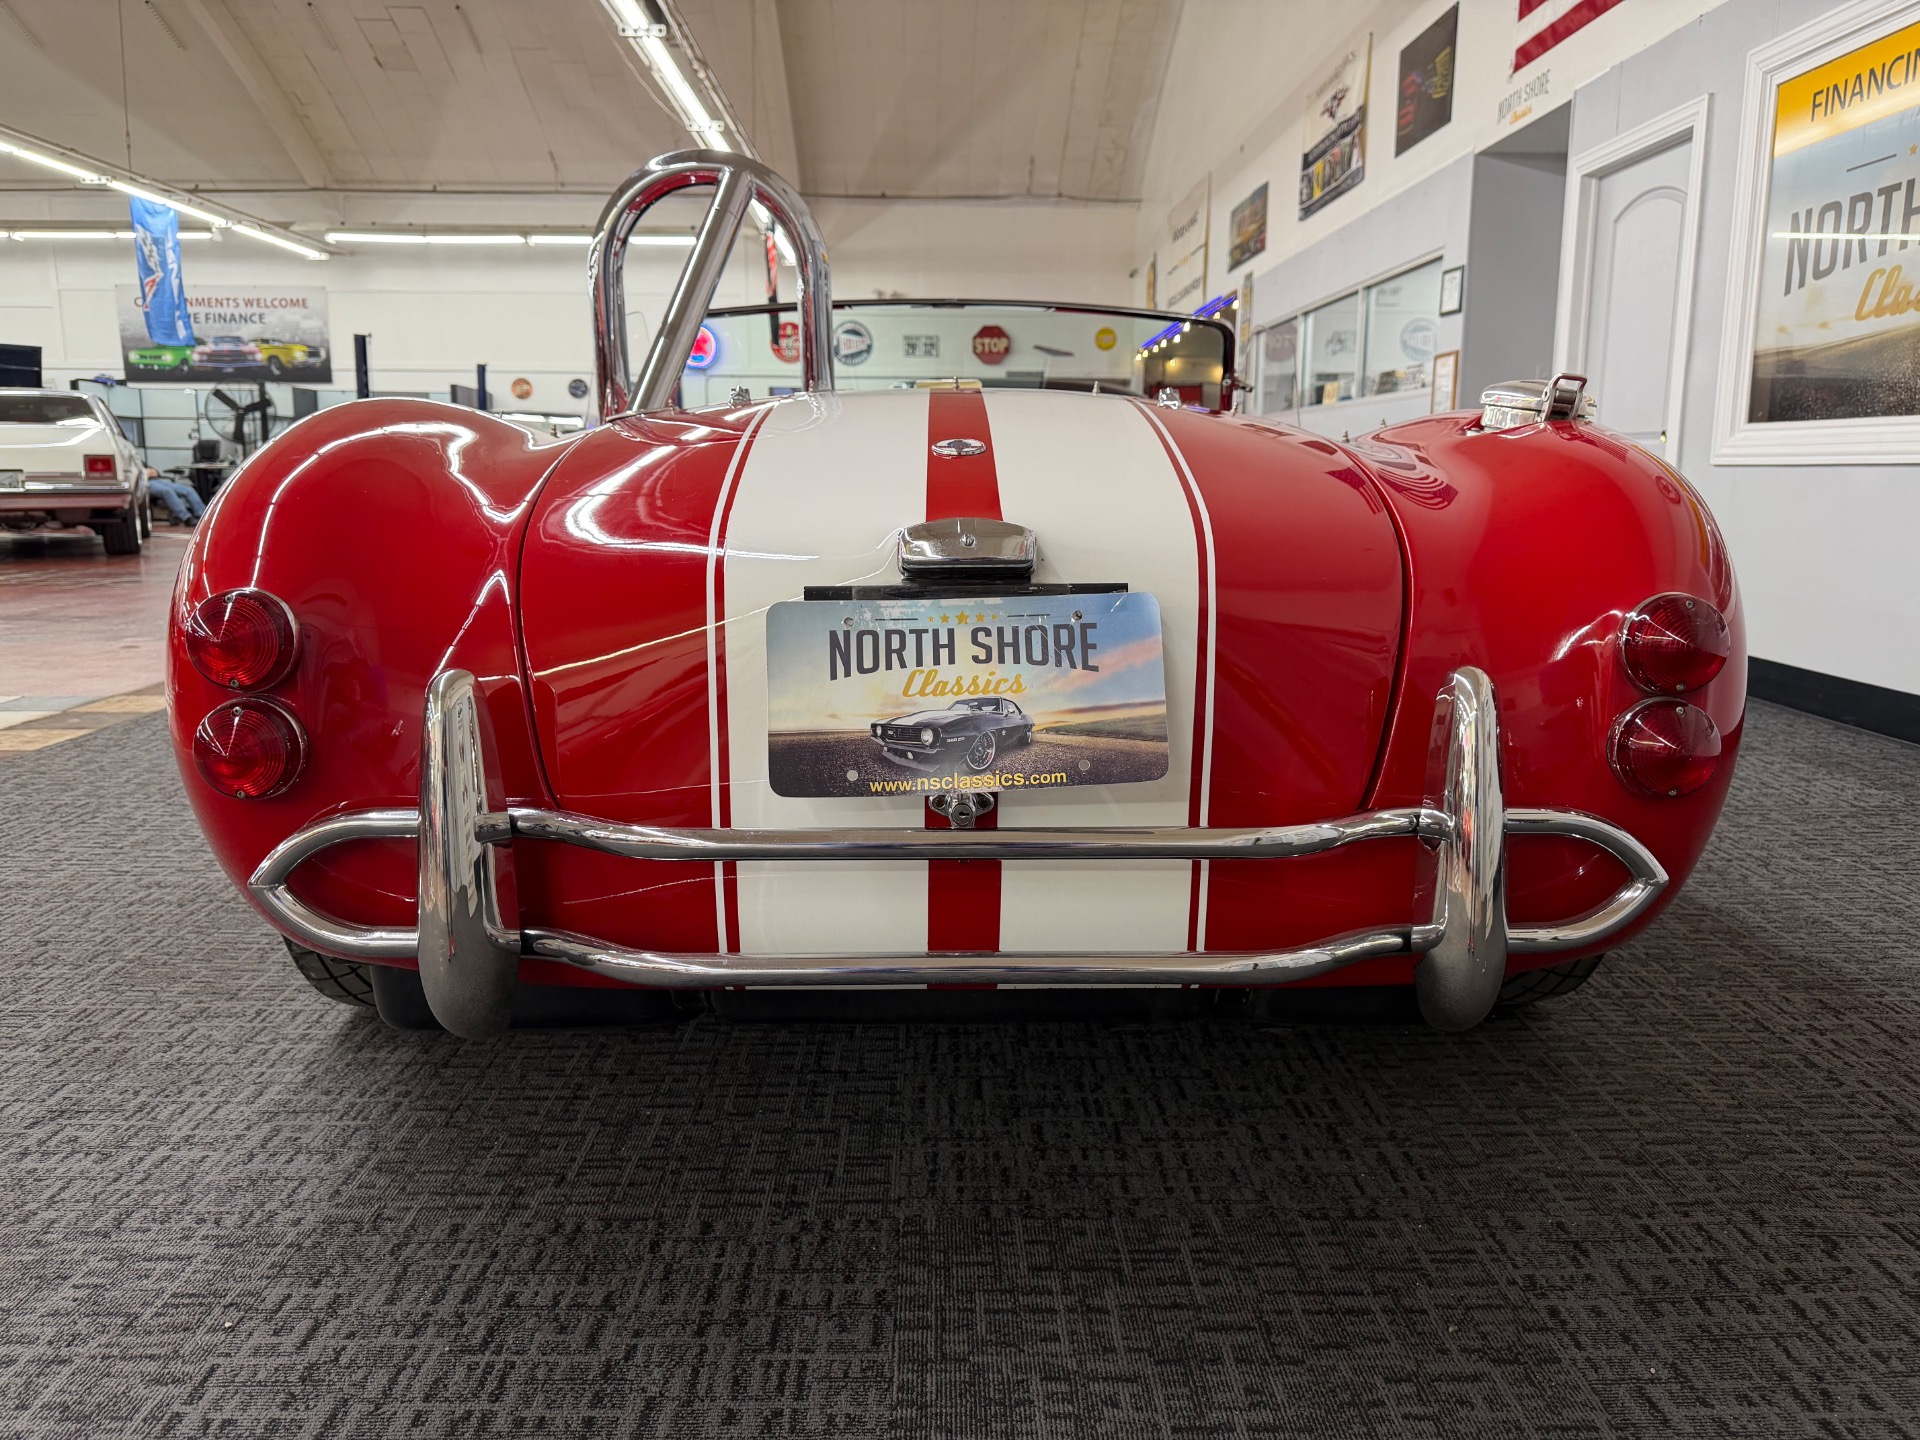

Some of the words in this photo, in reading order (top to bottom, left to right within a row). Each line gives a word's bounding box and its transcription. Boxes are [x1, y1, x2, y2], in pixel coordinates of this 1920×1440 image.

[1496, 87, 1522, 125] NORTH
[1523, 68, 1551, 102] SHORE
[243, 297, 309, 309] WELCOME
[204, 312, 267, 325] FINANCE
[974, 337, 1009, 354] STOP
[829, 627, 956, 681] NORTH
[970, 622, 1100, 673] SHORE
[901, 668, 1028, 698] Classics
[869, 770, 1068, 793] www.nsclassics.com
